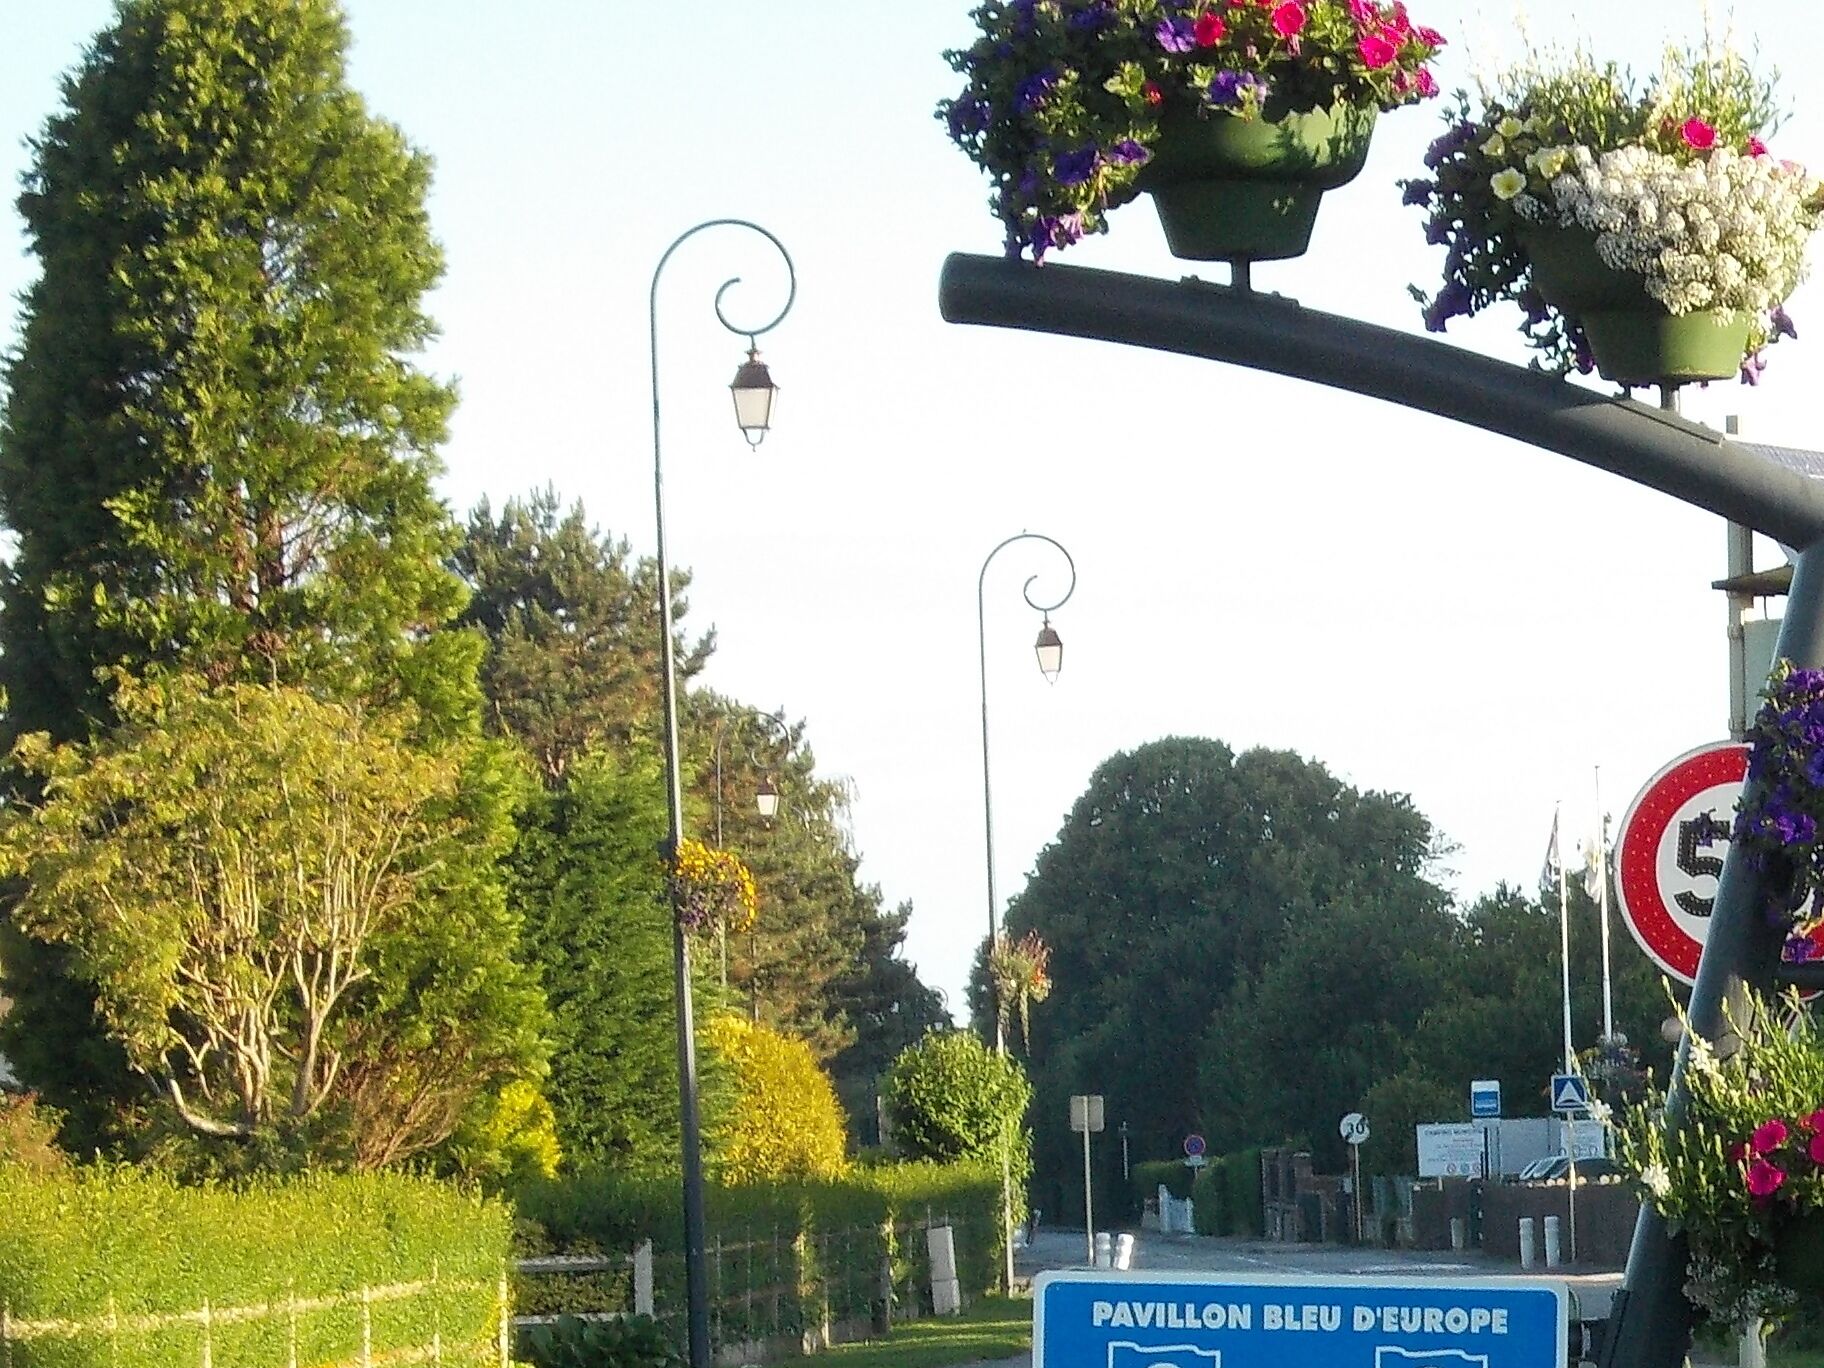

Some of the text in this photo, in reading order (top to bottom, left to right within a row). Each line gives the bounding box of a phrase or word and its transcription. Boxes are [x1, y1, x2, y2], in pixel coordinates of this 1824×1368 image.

[1092, 1301, 1508, 1335] PAVILLON BLEU D'EUROPE
